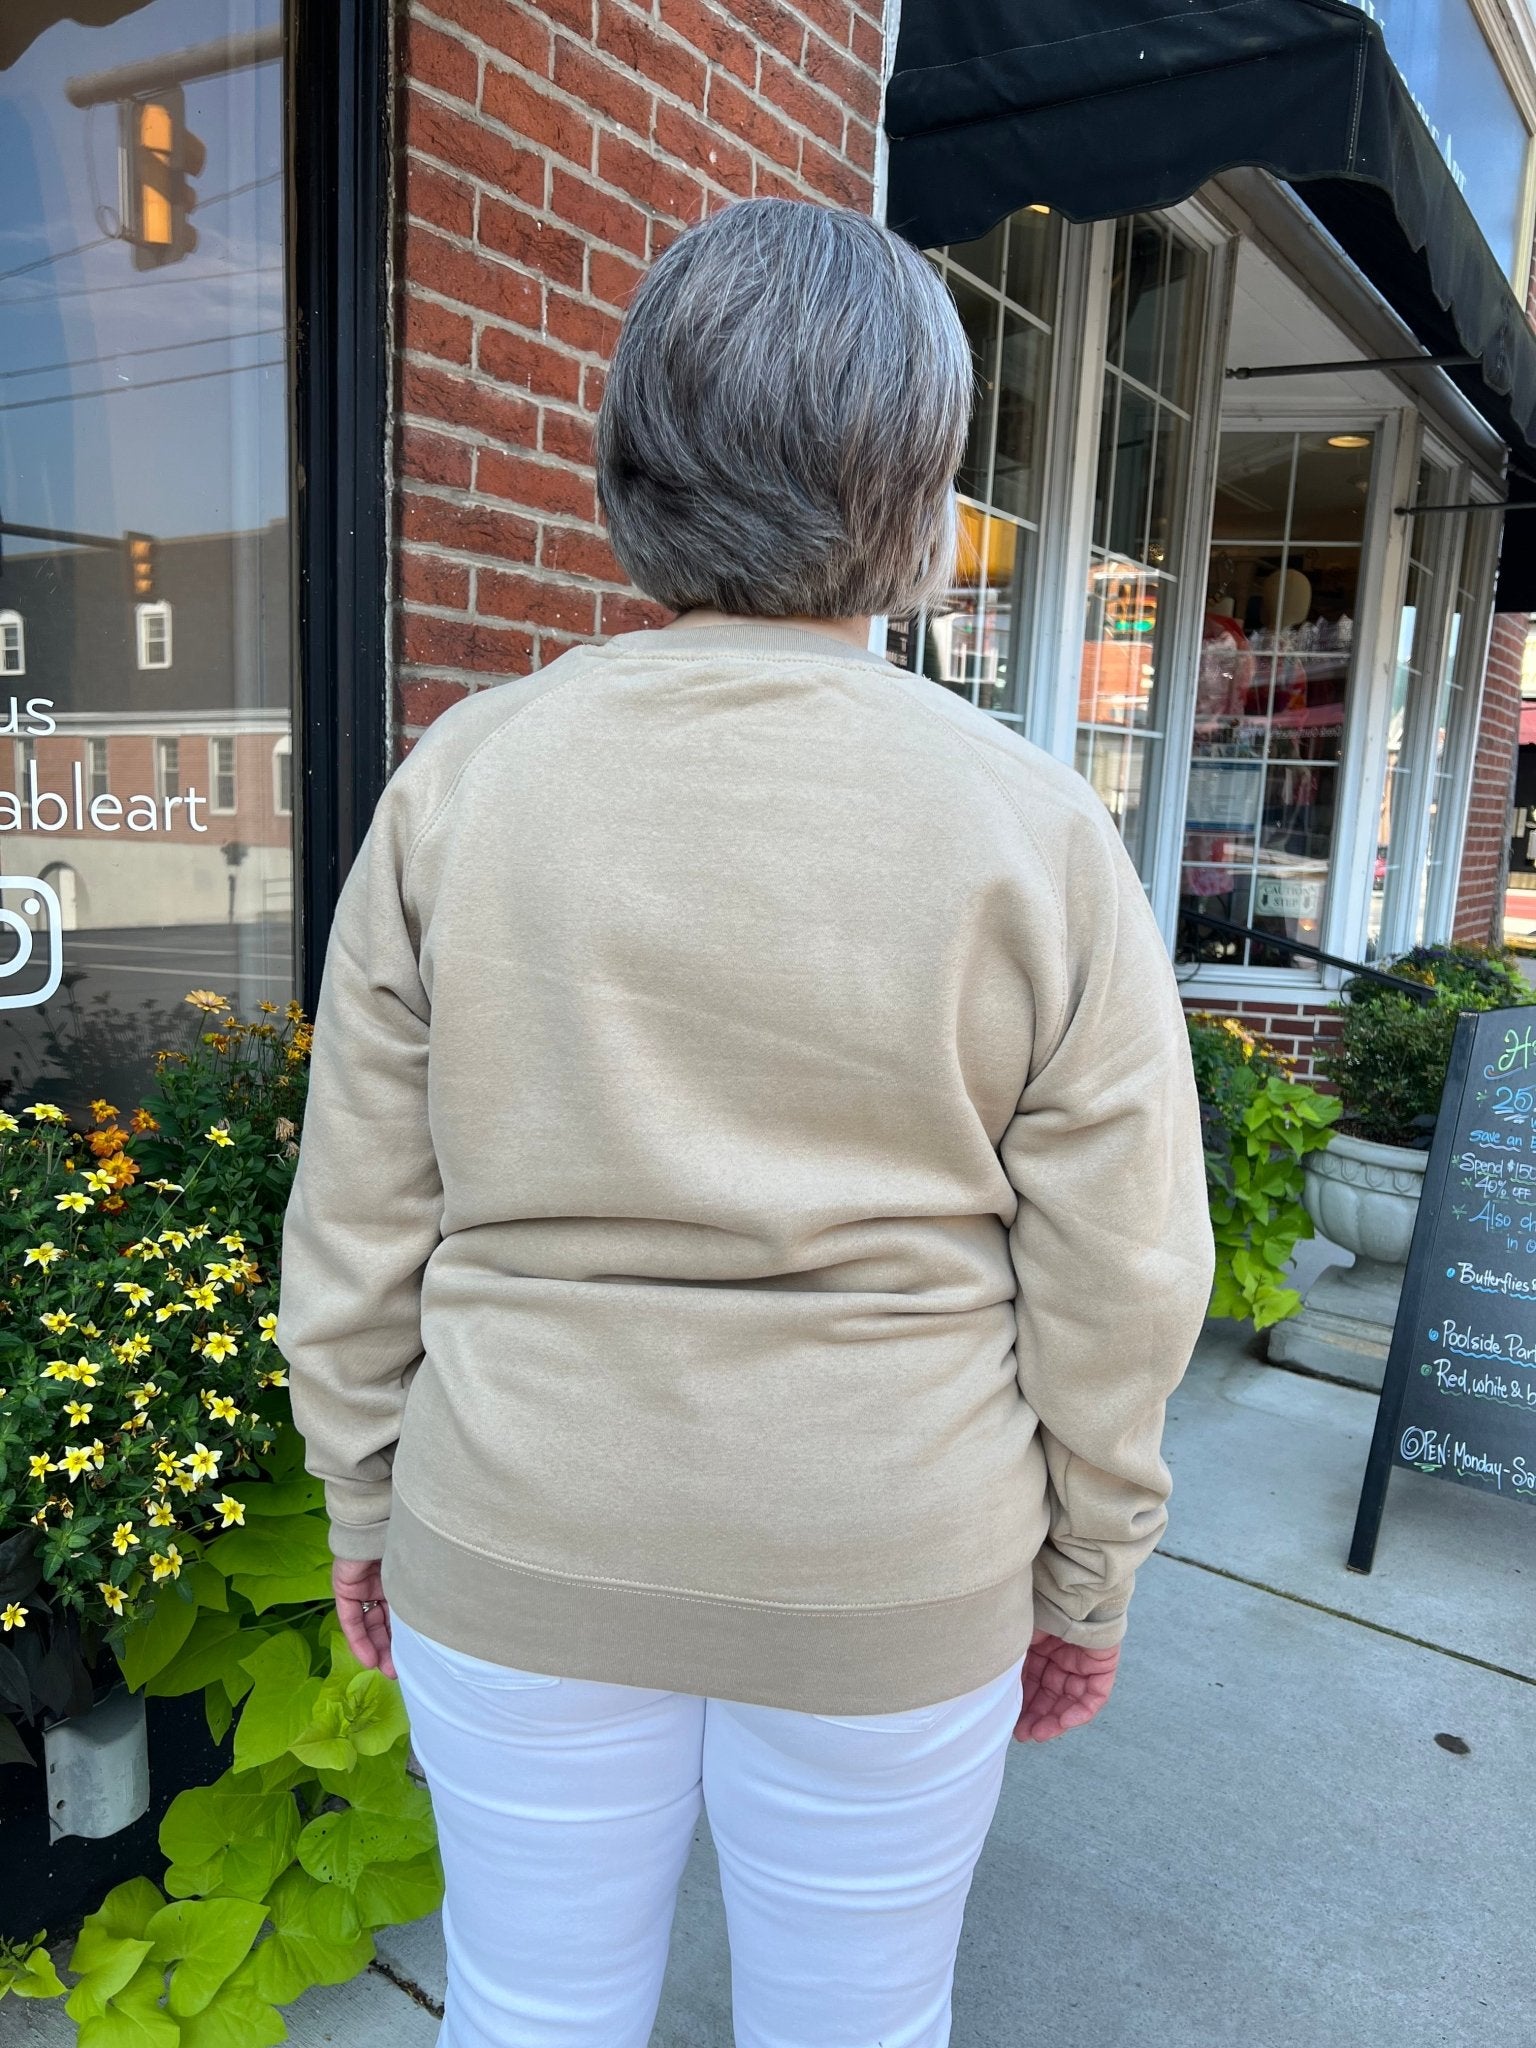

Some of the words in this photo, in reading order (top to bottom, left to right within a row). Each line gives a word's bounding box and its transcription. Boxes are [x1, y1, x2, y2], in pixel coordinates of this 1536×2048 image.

[1506, 1135, 1523, 1147] an
[1459, 1152, 1504, 1180] Spend
[1474, 1175, 1508, 1199] 40%
[1468, 1199, 1512, 1233] Also
[1506, 1233, 1519, 1251] in
[1457, 1261, 1530, 1295] Butterflies
[1442, 1319, 1502, 1354] Poolside
[1510, 1380, 1523, 1399] &
